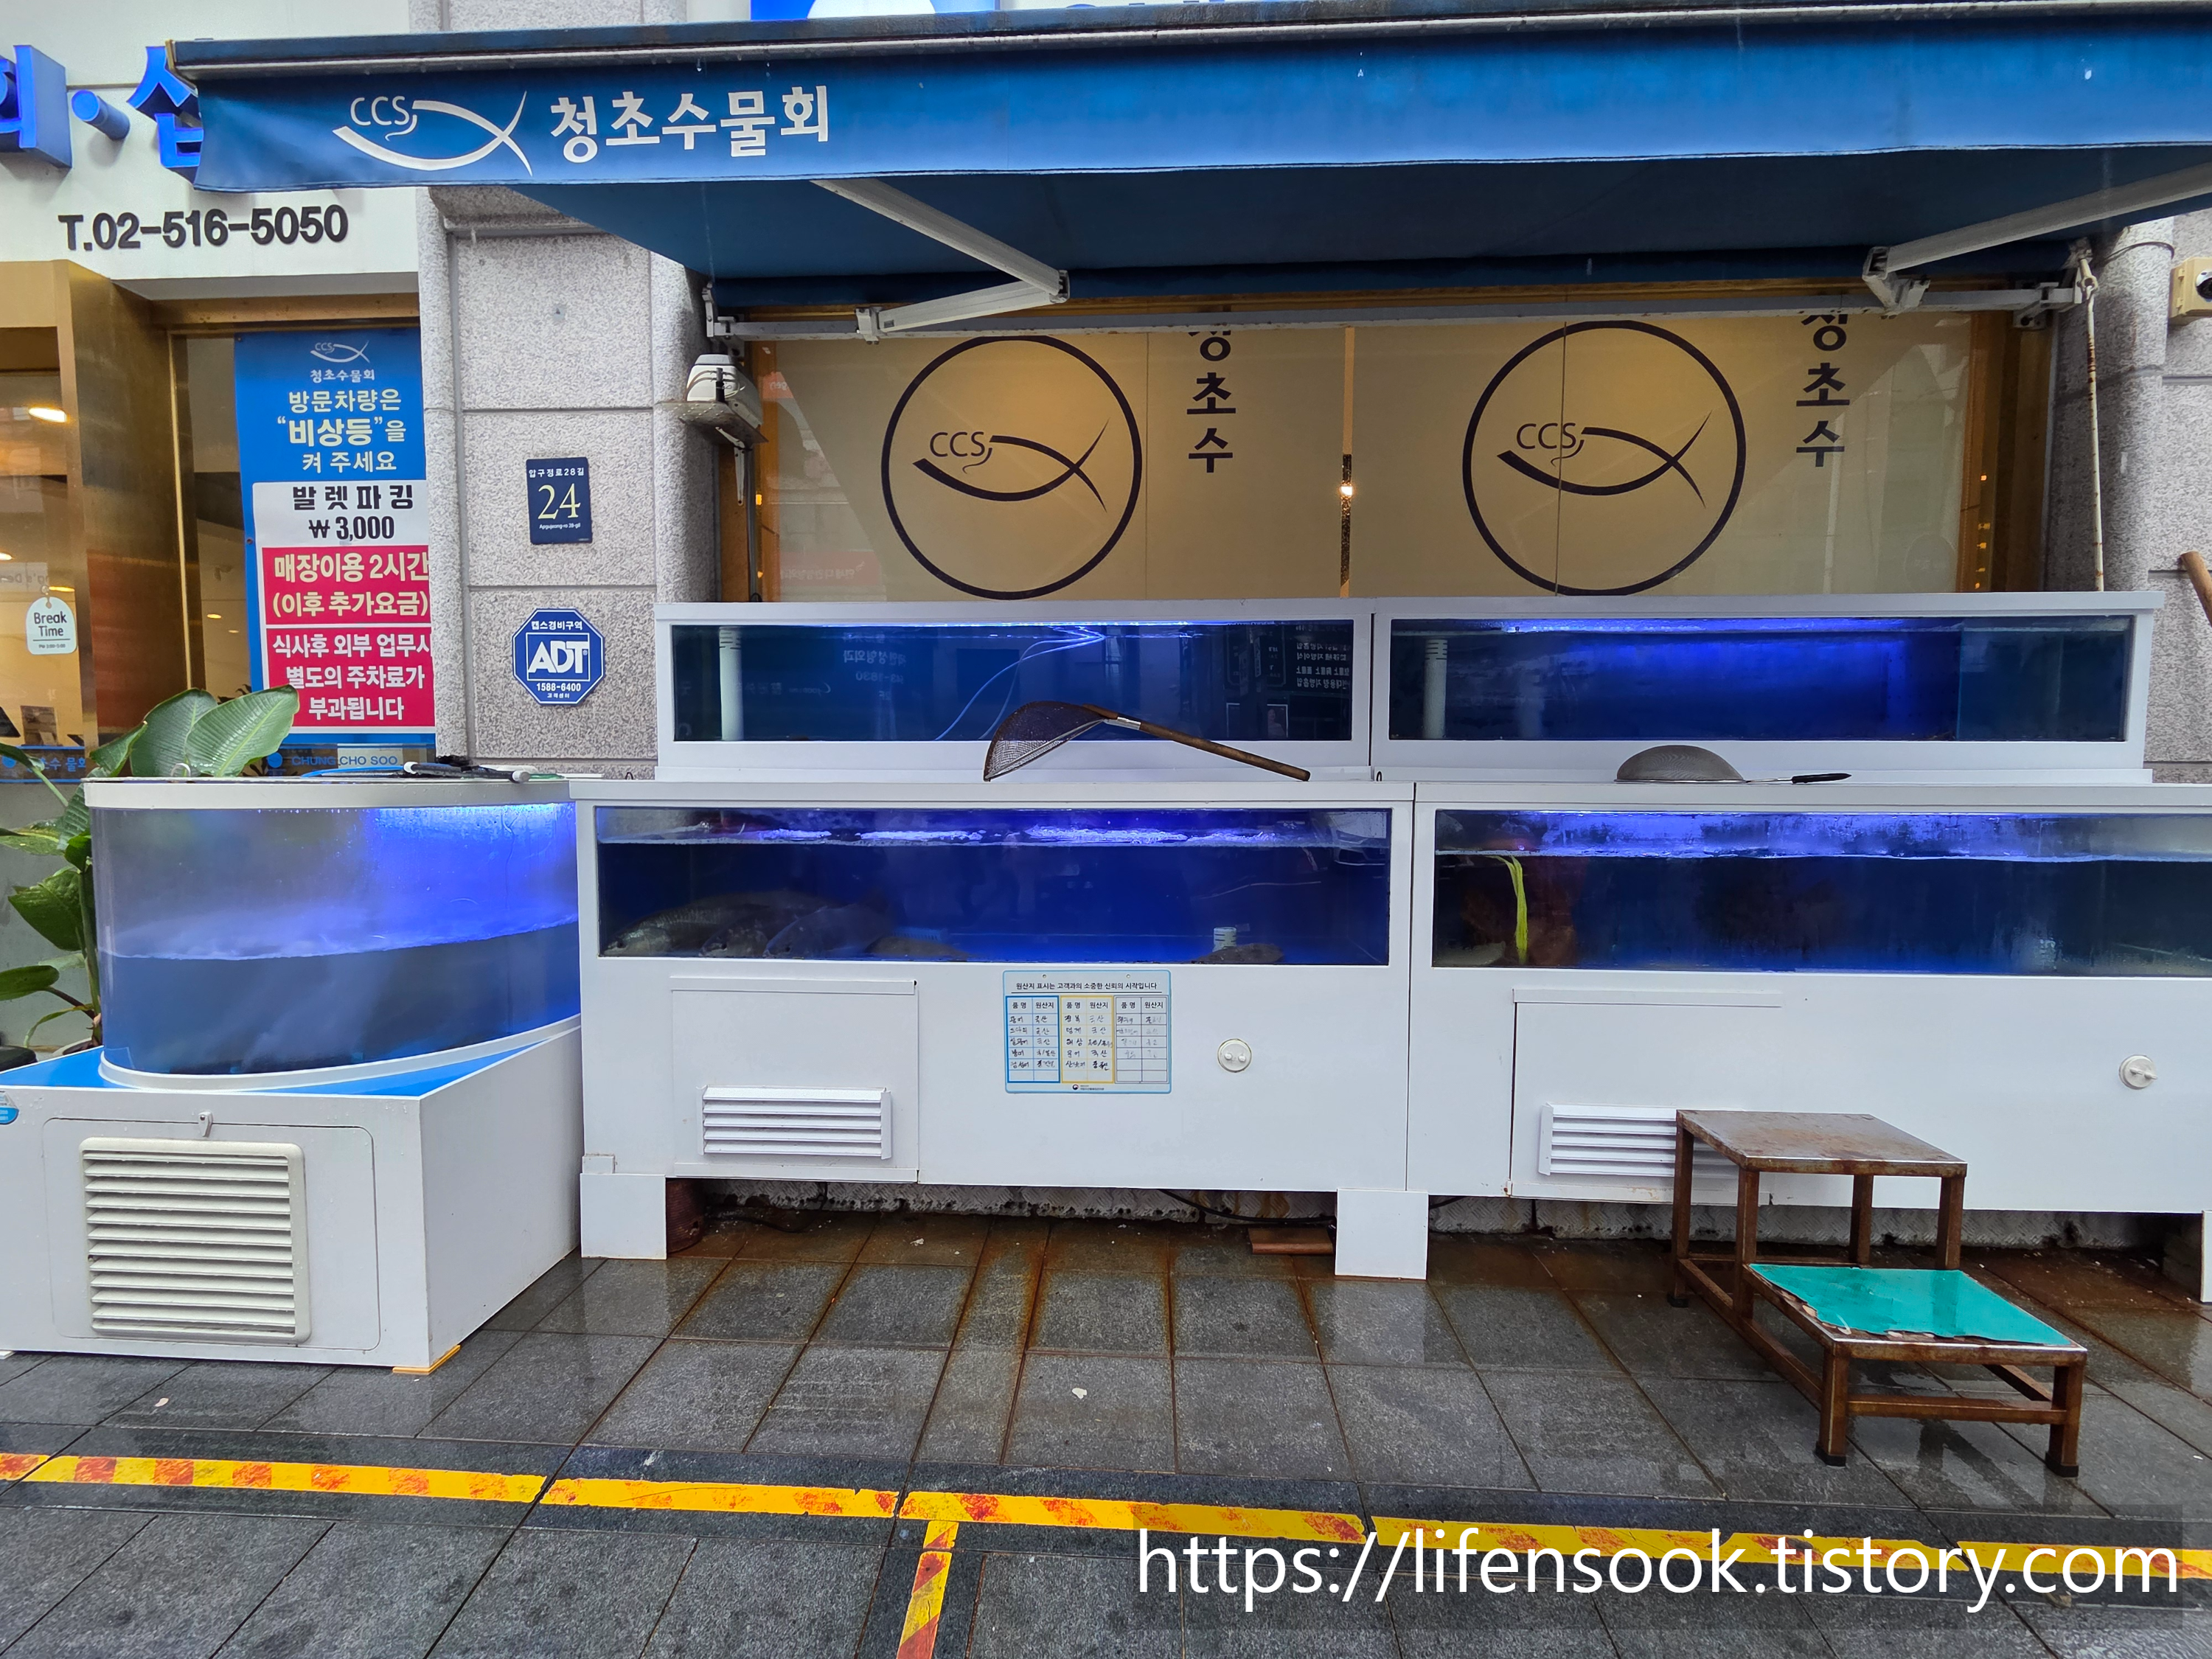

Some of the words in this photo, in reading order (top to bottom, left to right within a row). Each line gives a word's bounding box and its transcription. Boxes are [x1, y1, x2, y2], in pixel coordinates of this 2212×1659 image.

[350, 96, 414, 130] CCS
[550, 85, 829, 164] 청초수물회
[58, 205, 348, 251] T.02-516-5050
[315, 342, 335, 352] CCS
[310, 369, 375, 383] 청초수물회
[288, 389, 402, 413] 방문차량은
[930, 431, 988, 460] CCS
[1516, 422, 1579, 452] CCS
[302, 451, 321, 473] 켜
[330, 451, 397, 473] 주세요
[529, 467, 585, 479] 압구정로28길
[538, 483, 581, 519] 24
[274, 552, 365, 582] 매장이용
[369, 552, 429, 581] 2시간
[273, 591, 325, 617] (이후
[329, 591, 428, 616] 추가요금)
[34, 611, 68, 624] Break
[38, 625, 63, 637] Time
[273, 633, 330, 658] 식사후
[334, 633, 372, 657] 외부
[528, 640, 588, 674] ADT
[286, 665, 342, 689] 별도의
[347, 665, 425, 689] 주차료가
[537, 683, 581, 692] 1588-6400
[308, 697, 405, 720] 부과됩니다
[291, 756, 336, 766] CHUNG
[339, 756, 367, 765] CHO
[370, 755, 398, 765] SOO
[1016, 982, 1035, 990] 원산지
[1037, 982, 1056, 990] 표시는
[1057, 982, 1082, 990] 고객과의
[1084, 982, 1103, 990] 소중한
[1105, 982, 1124, 990] 신뢰의
[1126, 982, 1158, 990] 시작입니다
[1035, 1001, 1054, 1009] 원산지
[1090, 1001, 1108, 1009] 원산지
[1144, 1001, 1164, 1009] 원산지
